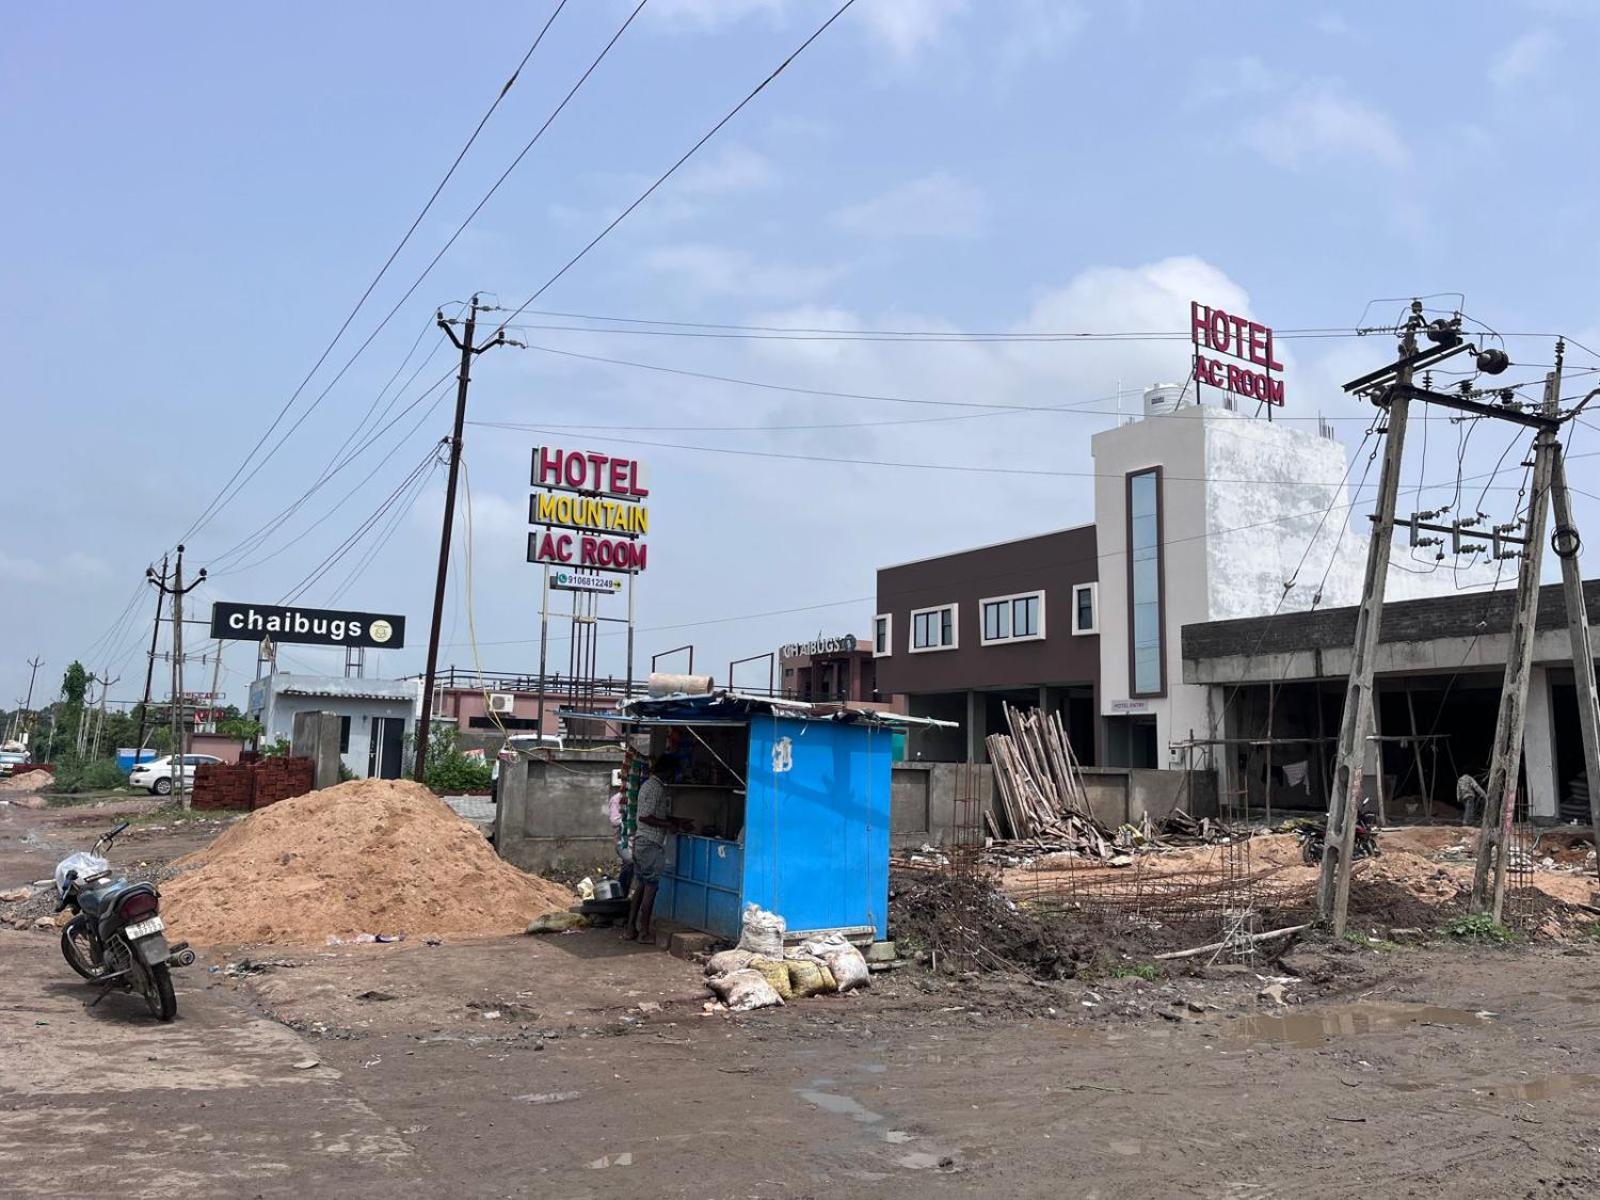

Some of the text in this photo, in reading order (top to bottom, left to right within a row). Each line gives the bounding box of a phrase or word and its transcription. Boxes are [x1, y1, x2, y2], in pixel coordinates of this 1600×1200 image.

[1191, 301, 1284, 372] HOTEL
[1194, 355, 1285, 407] AC ROOM
[540, 446, 649, 497] HOTEL
[538, 493, 648, 534] MOUNTAIN
[538, 533, 647, 571] AC ROOM
[568, 575, 613, 588] 9106812249
[229, 609, 362, 640] chaibugs
